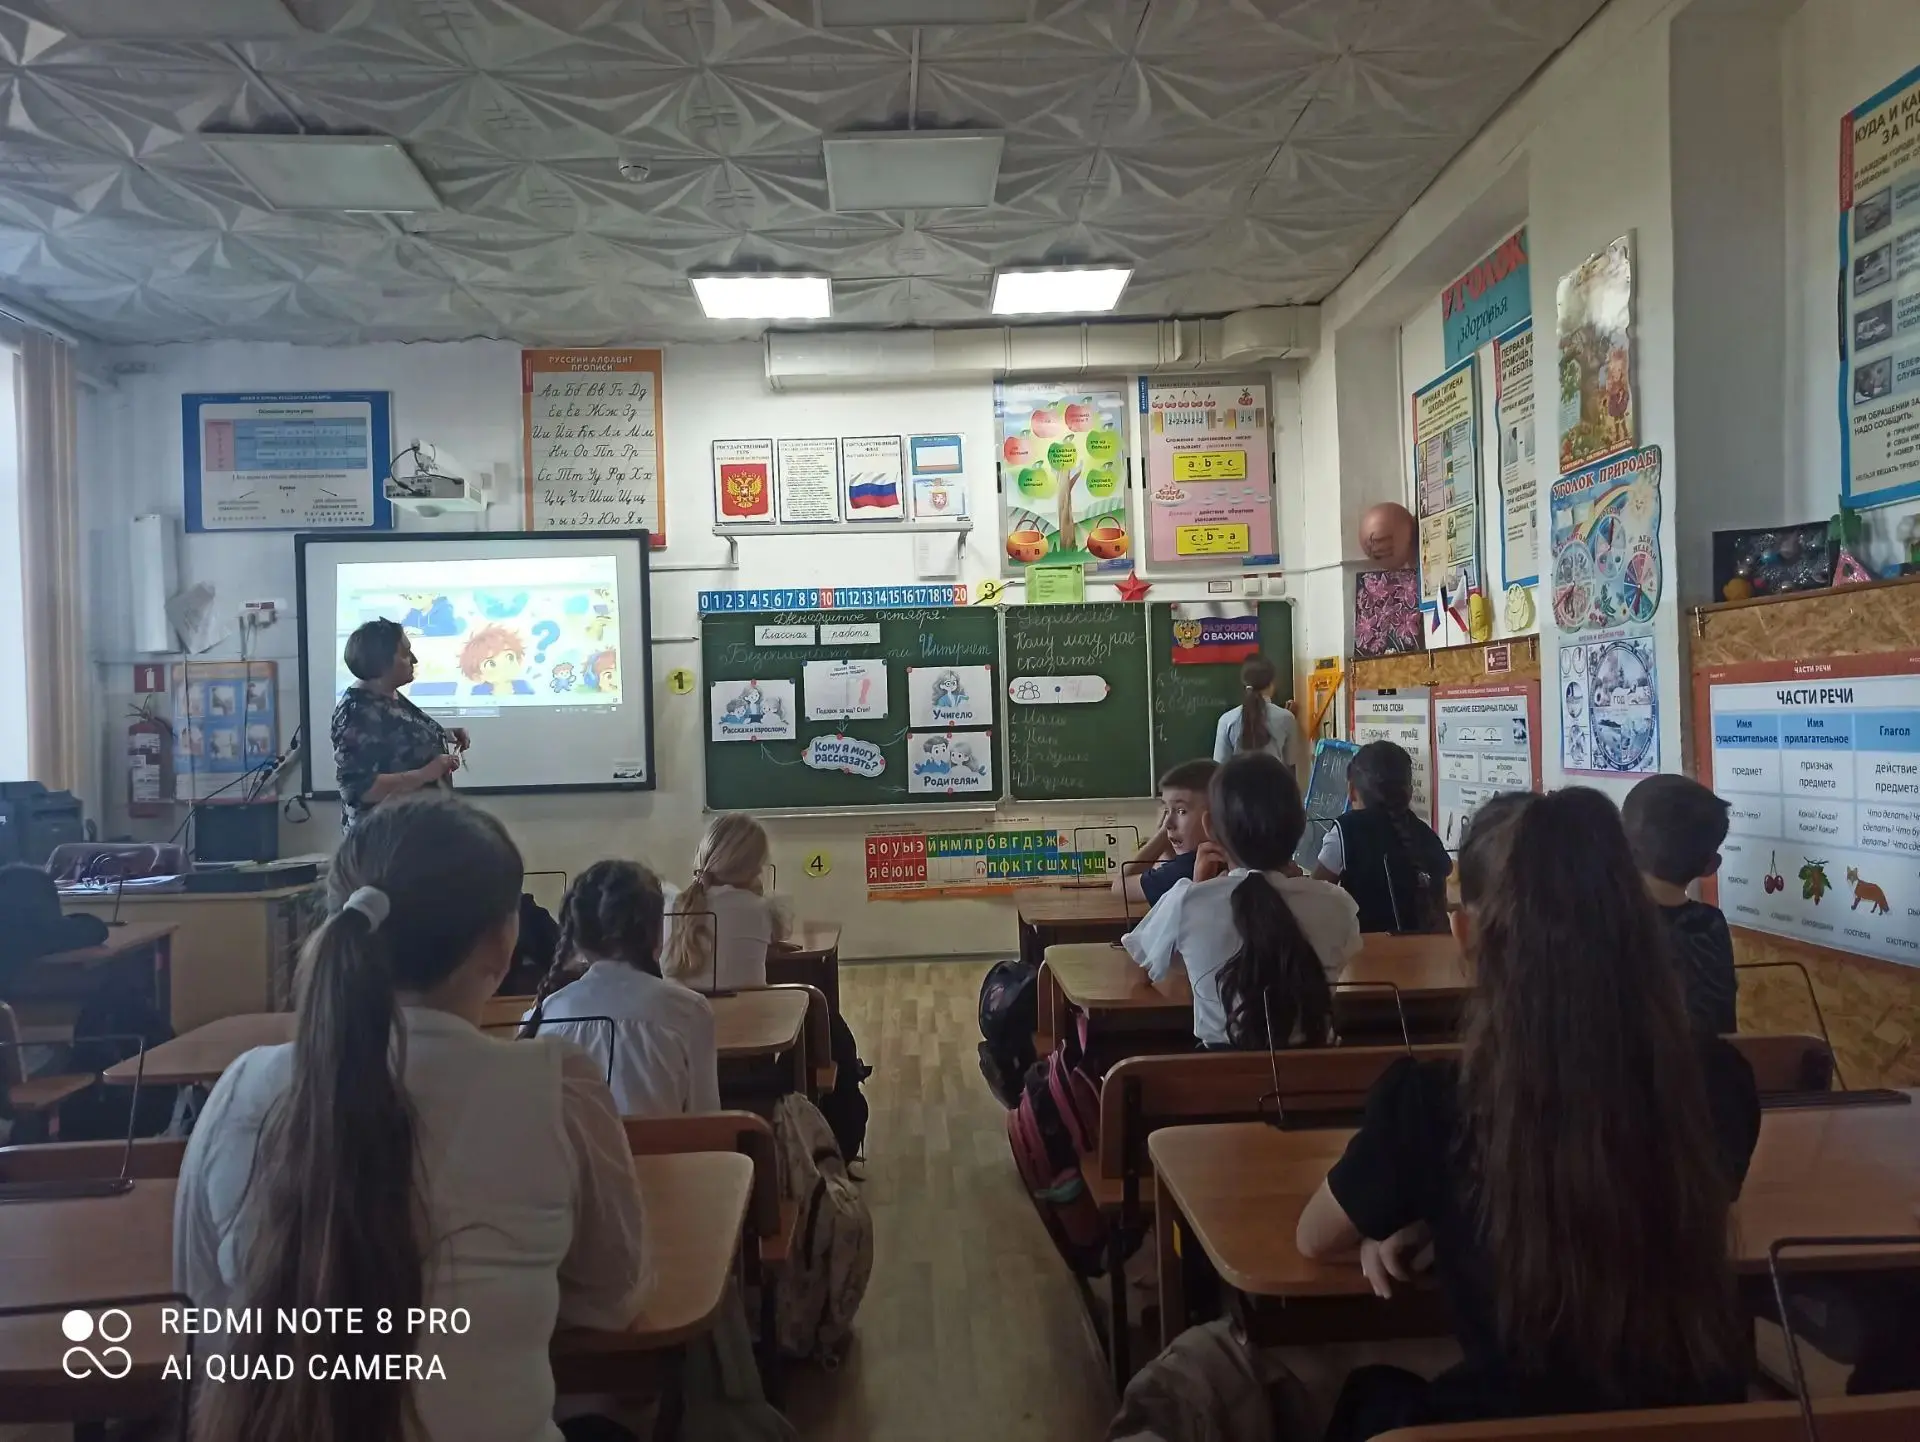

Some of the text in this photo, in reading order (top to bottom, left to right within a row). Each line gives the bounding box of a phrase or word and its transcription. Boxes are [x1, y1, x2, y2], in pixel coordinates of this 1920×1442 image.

[1855, 89, 1920, 144] КУДА И КА
[1882, 124, 1900, 145] ЗА
[1501, 338, 1525, 358] ПЕРВАЯ
[1501, 347, 1529, 369] ПОМОЩЬ
[1853, 401, 1910, 424] ПРИ ОБРАЩЕНИИ
[1854, 423, 1873, 436] НАДО
[1552, 472, 1594, 500] УГОЛОК
[1599, 448, 1657, 483] ПРИРОДЫ
[701, 588, 967, 608] 0 1 2 3 4 5 6 7 8 9 10 11 12 13 14 15 16 17 18 19 20
[761, 628, 870, 641] Классная работа
[1203, 624, 1258, 632] РАЗГОВОРЫ
[1211, 632, 1254, 641] ВАЖНОМ
[1794, 665, 1832, 674] ЧАСТИ РЕЧИ
[673, 671, 684, 690] 1
[1776, 688, 1853, 705] ЧАСТИ РЕЧИ
[1372, 703, 1404, 712] СОСТАВ СЛОВА
[1736, 719, 1752, 728] Имя
[1807, 718, 1824, 728] Имя
[722, 726, 754, 735] Расскажи
[1879, 725, 1910, 738] Глагол
[1715, 735, 1778, 745] существительное
[1784, 735, 1849, 745] прилагательное
[814, 742, 840, 754] Кому
[851, 746, 877, 760] могу
[814, 753, 879, 771] рассказать?
[1800, 761, 1833, 772] признак
[1875, 762, 1917, 775] действие
[1732, 766, 1762, 776] предмет
[1799, 778, 1836, 789] предмета
[1875, 782, 1919, 795] предмета
[1867, 808, 1913, 820] Что делать?
[1862, 823, 1911, 835] сделать? Что
[1861, 837, 1908, 850] делать? Что
[810, 855, 824, 872] 4
[1843, 928, 1871, 939] поспела
